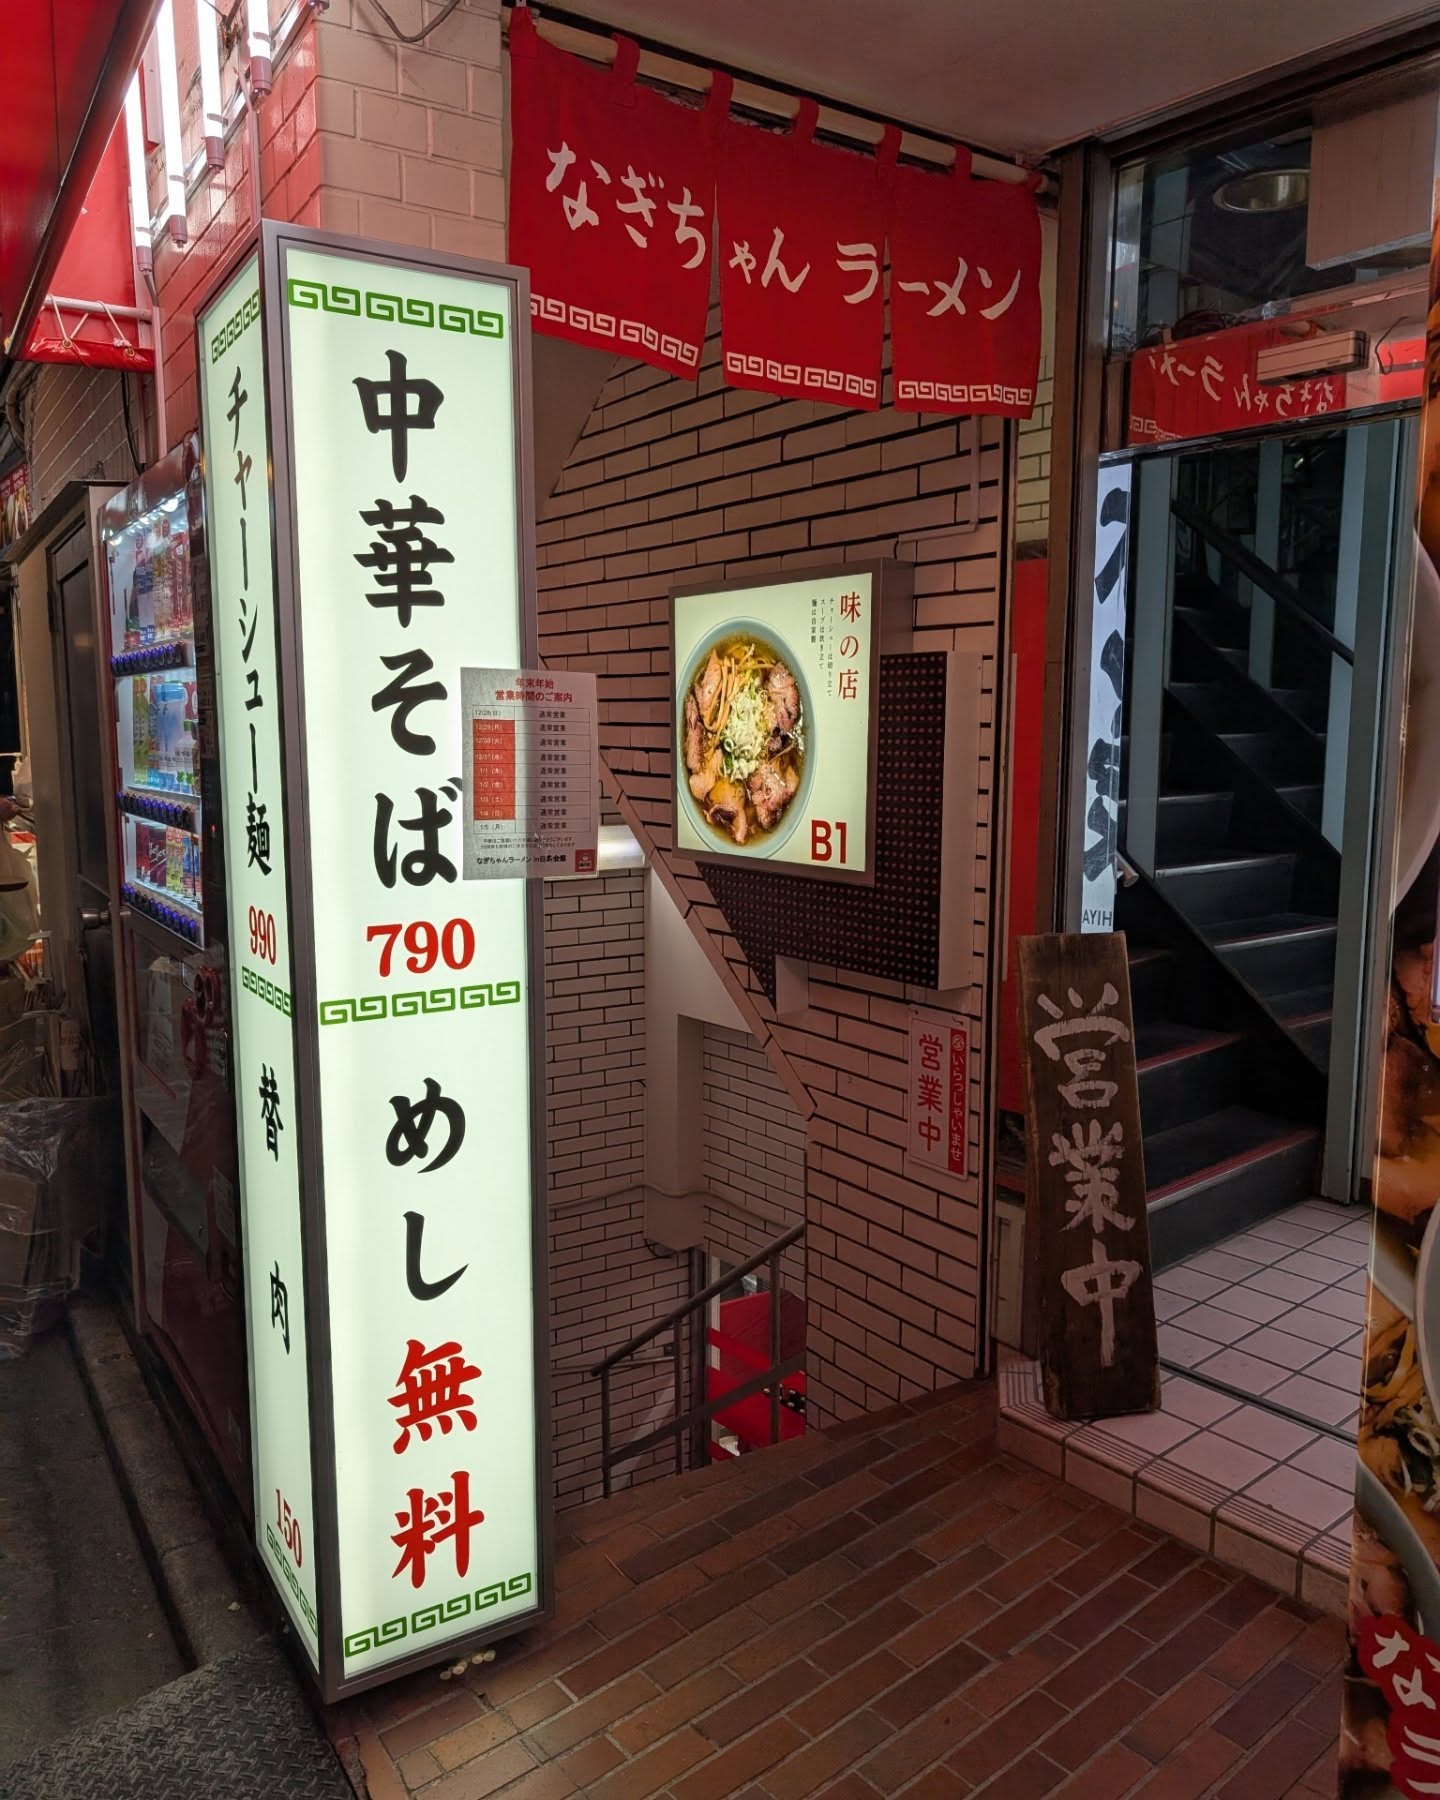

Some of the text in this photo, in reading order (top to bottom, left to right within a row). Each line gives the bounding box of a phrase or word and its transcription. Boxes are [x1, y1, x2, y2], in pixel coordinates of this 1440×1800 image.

[546, 141, 1021, 320] なぎちゃん ラーメン
[226, 364, 273, 877] チャーシュー麺
[352, 348, 463, 889] 中華そば
[838, 592, 861, 700] 味の店
[495, 690, 573, 703] 営業時間のご案内
[515, 677, 554, 690] 年末年始
[811, 820, 848, 863] B1
[248, 905, 277, 966] 990
[366, 918, 475, 977] 790
[917, 1033, 943, 1152] 営業中
[950, 1053, 964, 1162] いらっしゃいませ
[257, 1063, 292, 1357] 替肉
[1034, 982, 1143, 1367] 営業中
[274, 1487, 304, 1569] 150
